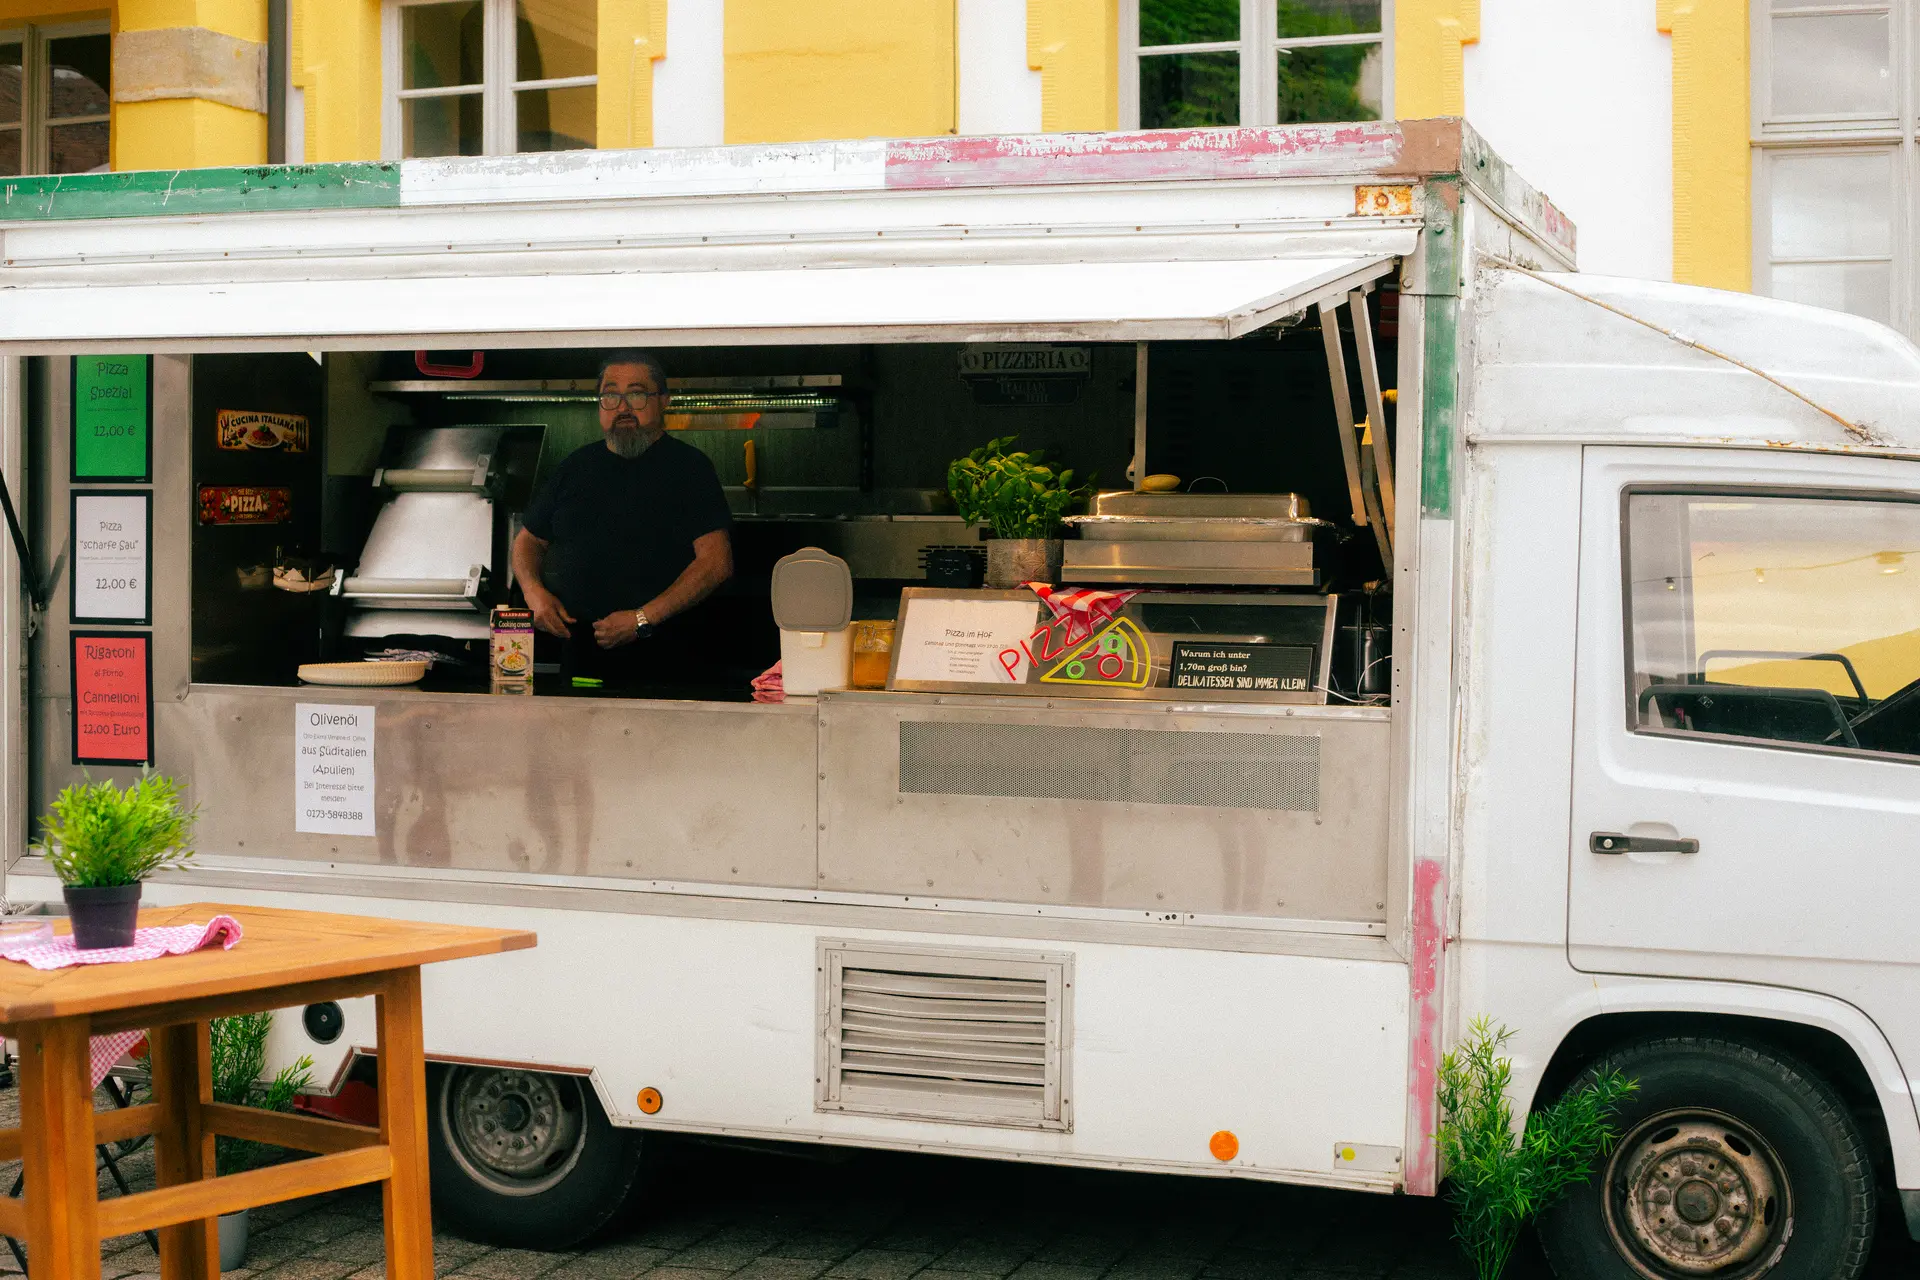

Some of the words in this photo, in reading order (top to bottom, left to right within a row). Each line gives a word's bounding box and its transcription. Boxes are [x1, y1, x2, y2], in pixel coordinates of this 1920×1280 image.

[982, 351, 1067, 369] PIZZERIA
[96, 361, 129, 377] Pizza
[90, 386, 132, 401] Spezial
[231, 415, 259, 427] CUCINA
[261, 415, 294, 431] ITALIANA
[94, 425, 124, 438] 12,00
[128, 425, 135, 436] €
[231, 495, 264, 512] PIZZA
[100, 521, 122, 531] Pizza
[96, 578, 126, 590] 12,00
[129, 578, 137, 589] €
[498, 620, 516, 629] Cooking
[945, 629, 965, 638] Pizza
[977, 631, 993, 639] Hof
[998, 604, 1114, 681] PIZZA
[85, 645, 135, 660] Rigatoni
[1180, 649, 1211, 659] Warum
[1213, 651, 1226, 659] ich
[1179, 663, 1206, 672] 1,70m
[1207, 664, 1228, 673] groß
[1230, 665, 1248, 673] bin?
[1177, 675, 1235, 688] DELIKATESSEN
[1236, 677, 1253, 688] SIND
[1254, 677, 1279, 689] IMMER
[1280, 678, 1307, 690] KLEIN!
[83, 691, 140, 704] Cannelloni
[310, 711, 358, 727] Olivenöl
[113, 723, 141, 736] Euro
[301, 745, 317, 755] aus
[319, 745, 367, 757] Süditalien
[312, 764, 355, 776] (Apulien)
[304, 781, 314, 789] Bei
[315, 782, 347, 791] Interesse
[347, 783, 365, 792] bitte
